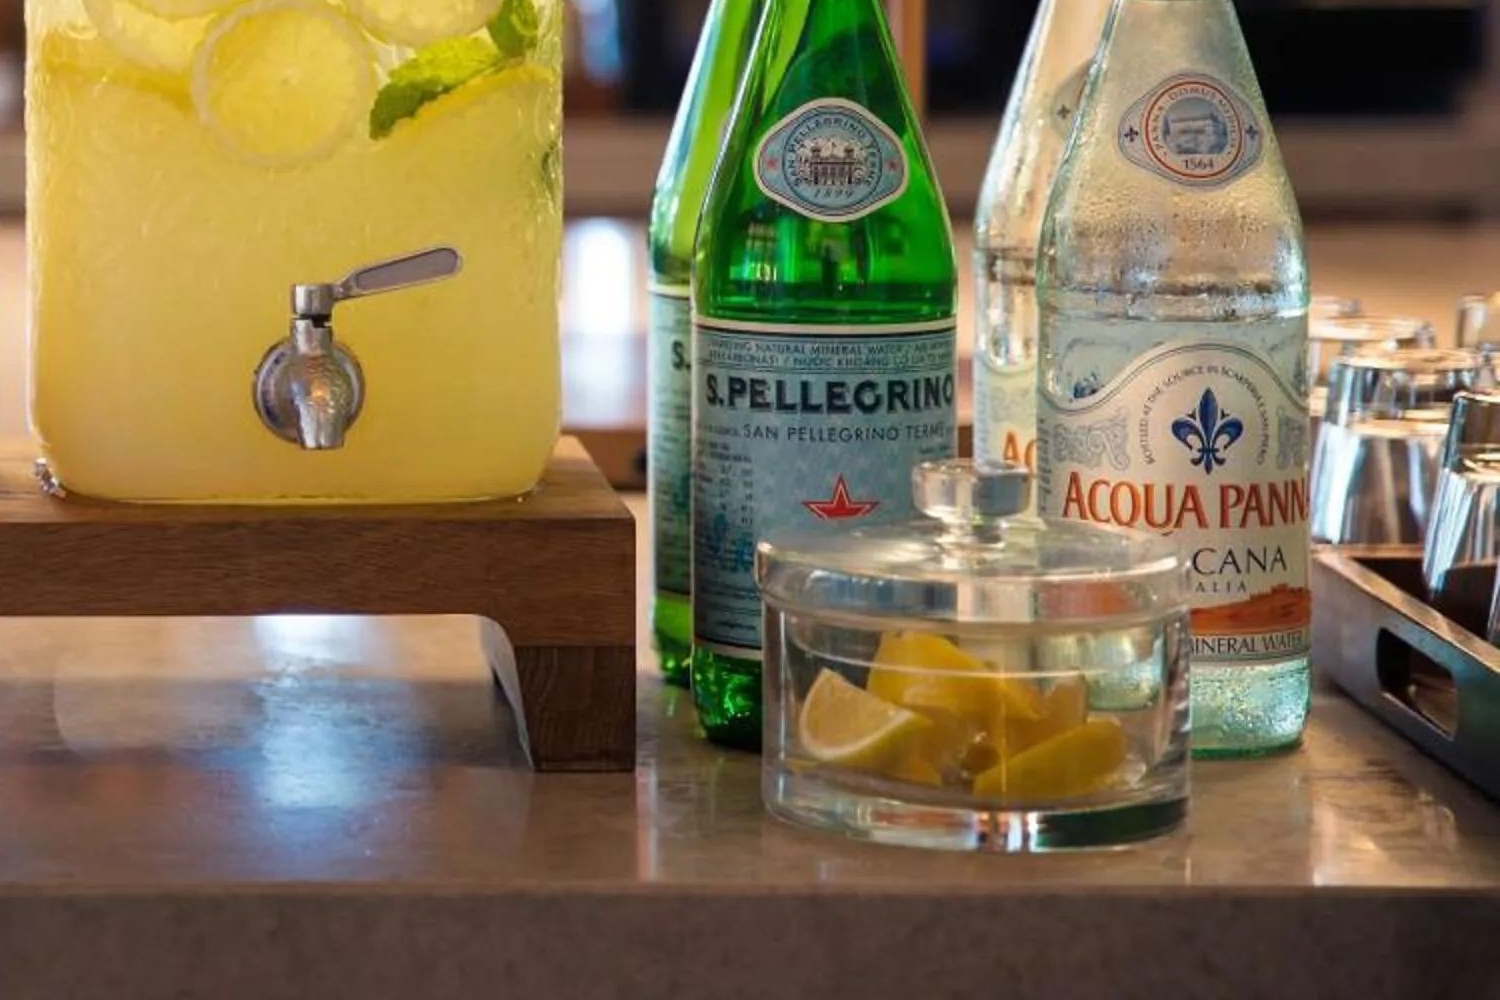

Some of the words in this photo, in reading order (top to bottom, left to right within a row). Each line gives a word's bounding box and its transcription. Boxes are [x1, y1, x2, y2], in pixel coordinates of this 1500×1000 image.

[788, 117, 867, 153] PELLEGRINO
[756, 343, 805, 355] NATURAL
[811, 344, 862, 356] MINERAL
[706, 372, 954, 414] S.PELLEGRINO
[742, 423, 779, 440] SAN
[787, 425, 899, 443] PELLEGRINO
[1061, 471, 1210, 536] ACQUA
[1218, 476, 1310, 530] PANN
[1192, 545, 1288, 576] CANA
